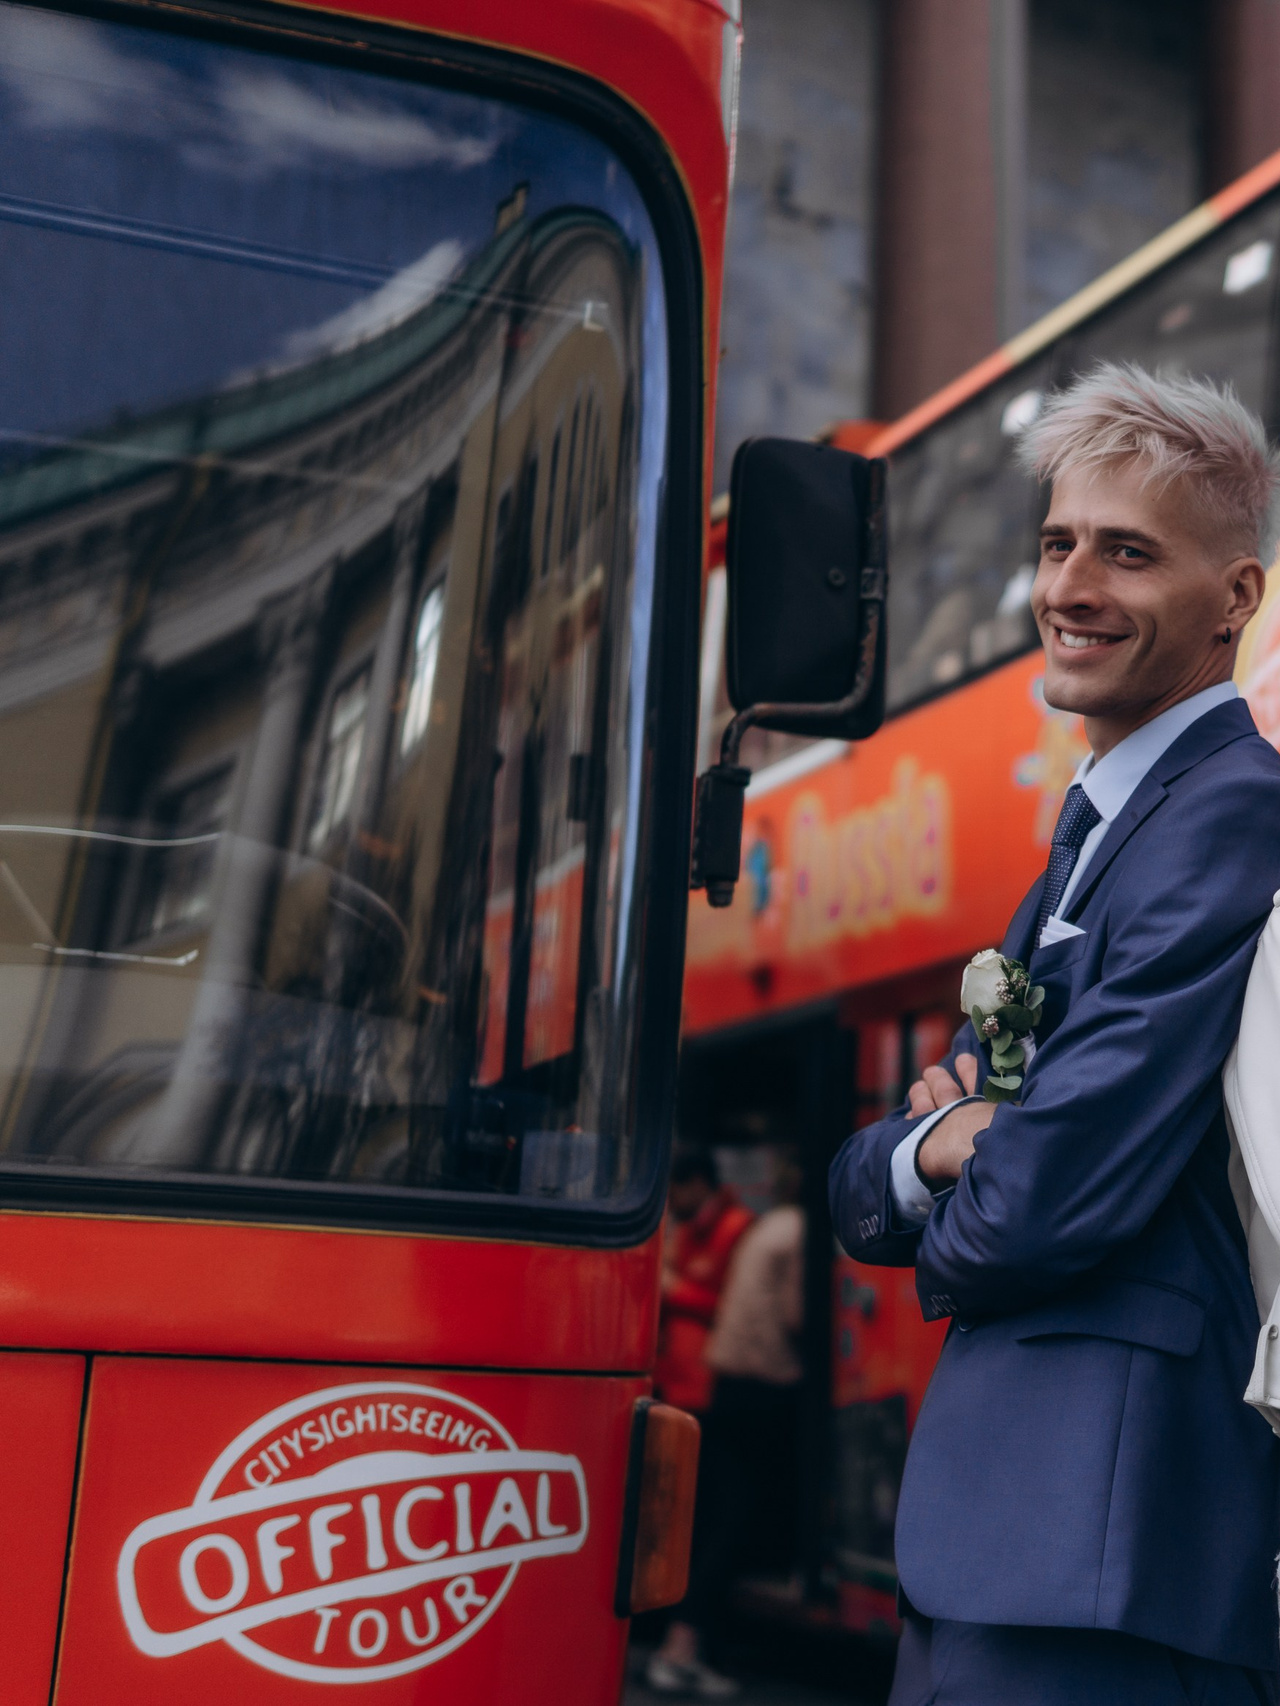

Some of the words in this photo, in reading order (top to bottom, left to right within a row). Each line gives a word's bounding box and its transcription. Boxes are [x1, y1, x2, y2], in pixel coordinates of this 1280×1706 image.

[244, 1402, 492, 1490] CITYSIGHTSEEING
[179, 1473, 568, 1615] OFFICIAL
[313, 1575, 489, 1658] TOUR
